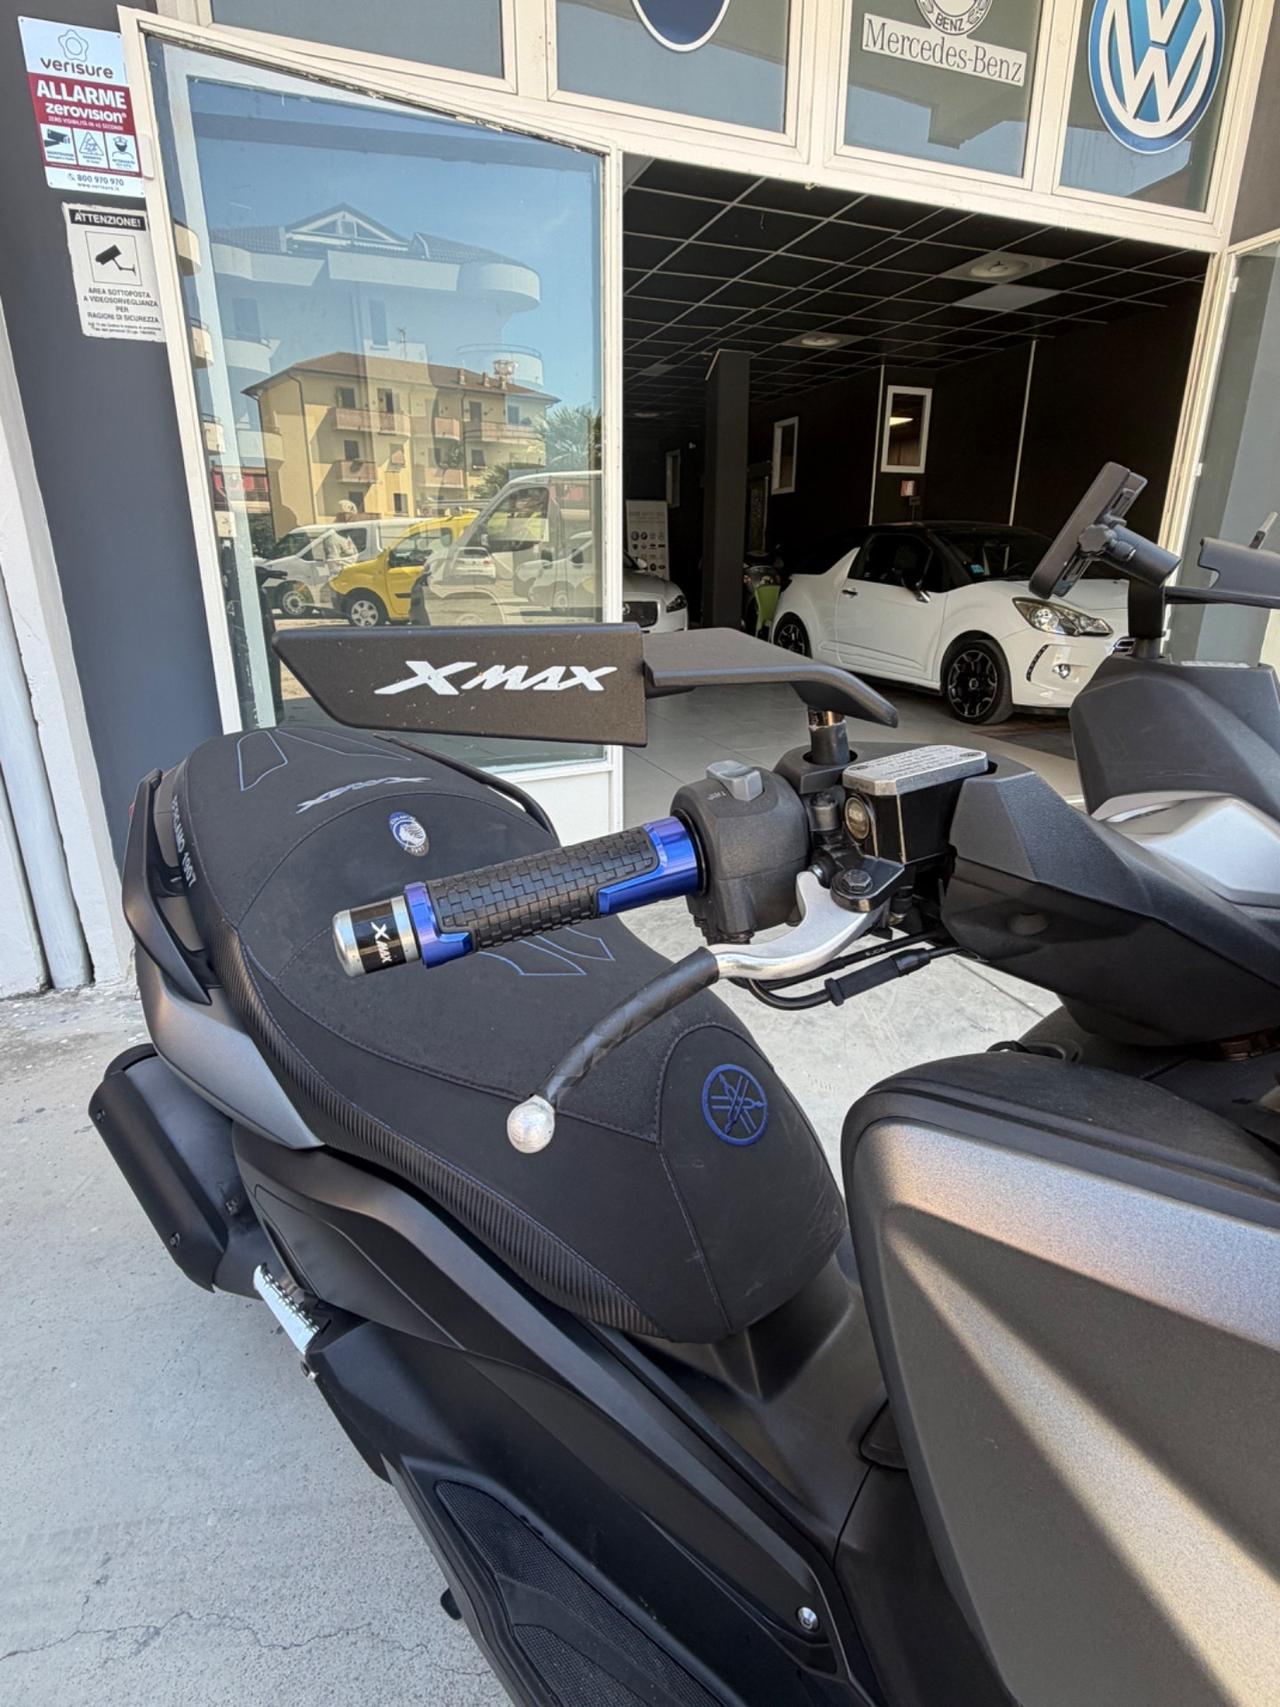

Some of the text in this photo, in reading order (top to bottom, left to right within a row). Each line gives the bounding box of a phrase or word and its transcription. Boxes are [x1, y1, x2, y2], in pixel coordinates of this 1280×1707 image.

[935, 13, 965, 32] BENZ
[864, 18, 1023, 83] Mercedes-Benz
[40, 57, 113, 79] verisure
[37, 79, 127, 109] ALLARME
[77, 174, 124, 187] 800 970 970
[74, 211, 141, 228] ATTENZIONE!
[88, 287, 151, 299] AREA SOTTOPOSTA
[87, 311, 159, 323] RAGIONI DI SICUREZZA
[115, 305, 129, 313] PER
